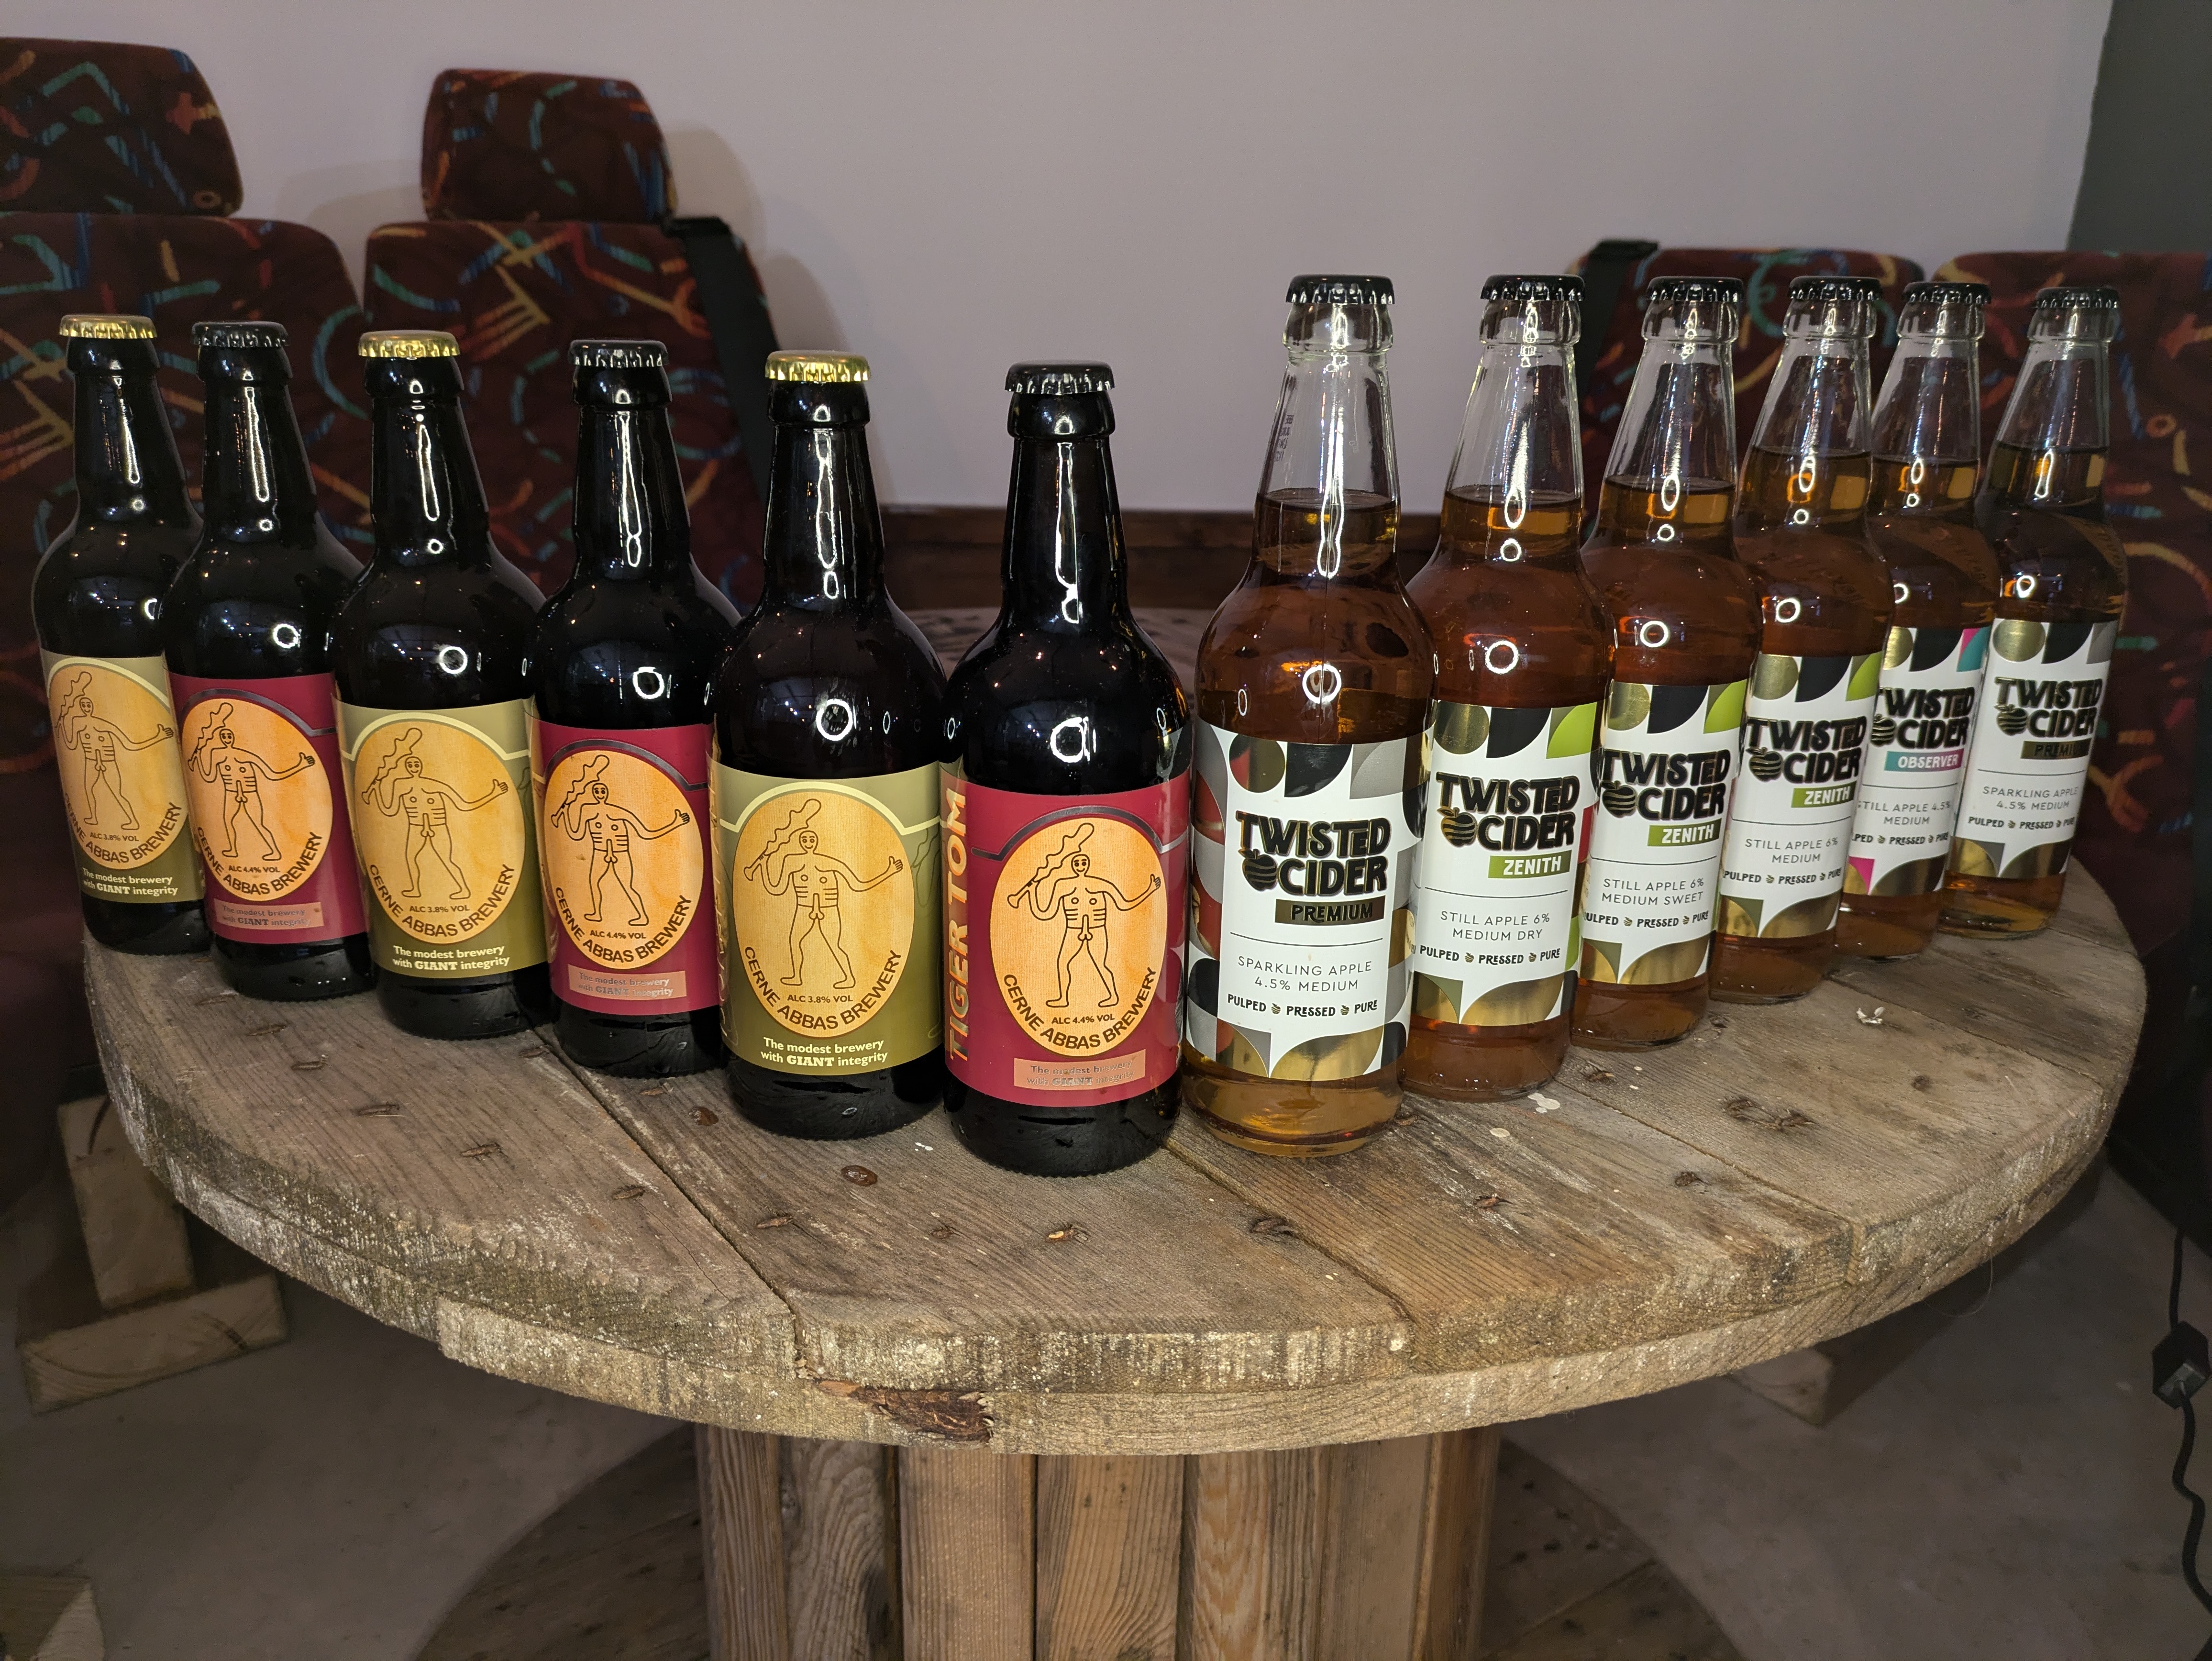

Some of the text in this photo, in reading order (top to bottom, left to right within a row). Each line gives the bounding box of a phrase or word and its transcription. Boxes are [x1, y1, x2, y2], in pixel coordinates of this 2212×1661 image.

[1994, 676, 2102, 709] TWISTED
[2027, 706, 2098, 738] CIDER
[1747, 716, 1867, 751] TWISTED
[1897, 717, 1969, 749] CIDER
[1603, 748, 1731, 787] TWISTED
[1783, 747, 1862, 784] CIDER
[1898, 754, 1958, 768] OBSERVER
[1436, 771, 1580, 814] TWISTED
[1803, 786, 1850, 805] ZENITH
[1982, 786, 2050, 798] SPARKLING
[1637, 783, 1726, 820] CIDER
[1892, 804, 1928, 812] APPLE
[1996, 800, 2069, 810] 4.5% MEDIUM
[1883, 817, 1930, 825] MEDIUM
[1968, 816, 2005, 828] PULPED
[2019, 821, 2054, 830] PRESSED
[86, 841, 129, 863] ABBAS
[130, 802, 182, 860] BREWERY
[90, 832, 102, 840] ALC
[1236, 810, 1391, 858] TWISTED
[1478, 812, 1576, 851] CIDER
[1661, 824, 1714, 844] ZENITH
[1745, 837, 1838, 850] STILL APPLE 6%
[1889, 836, 1925, 846] PRESSED
[198, 827, 323, 896] CERNE ABBAS BREWERY
[1503, 856, 1562, 875] ZENITH
[1771, 853, 1821, 864] MEDIUM
[82, 867, 172, 885] The modest brewery
[1278, 856, 1388, 896] CIDER
[1603, 877, 1704, 891] STILL APPLE 6%
[1723, 871, 1761, 883] PULPED
[1778, 874, 1816, 885] PRESSED
[97, 883, 130, 894] GIANT
[133, 886, 178, 897] integrity
[1602, 891, 1703, 905] MEDIUM SWEET
[370, 864, 515, 937] CERNE ABBAS BREWERY
[222, 905, 235, 913] The
[236, 908, 265, 916] modest
[1291, 902, 1373, 923] PREMIUM
[1440, 911, 1550, 926] STILL APPLE 6%
[238, 918, 269, 926] GIANT
[271, 918, 310, 927] integrity
[556, 887, 692, 963] CERNE ABBAS BREWERY
[946, 787, 969, 1061] TIGER TOM
[1584, 910, 1709, 929] ULPED PRESSED PURE
[590, 930, 605, 938] ALC
[1453, 928, 1543, 941] MEDIUM DRY
[393, 945, 505, 959] The modest brewery
[1420, 945, 1560, 965] PULPED PRESSED PURE
[392, 956, 510, 970] with GIANT integrity
[1238, 956, 1372, 976] SPARKLING APPLE
[578, 972, 670, 987] The modest brewery
[1255, 976, 1358, 992] 4.5% MEDIUM
[577, 983, 674, 998] with GIANT integrity
[745, 946, 901, 1030] CERNE ABBAS BREWERY
[1004, 967, 1156, 1050] CERNE ABBAS BREWERY
[1228, 994, 1378, 1017] PULPED PRESSED PURE
[1096, 1014, 1115, 1022] VOL
[763, 1037, 884, 1053] The modest brewery
[761, 1051, 888, 1067] with GIANT integrity
[1030, 1065, 1050, 1074] The
[1094, 1060, 1133, 1074] brewery
[1027, 1071, 1135, 1086] with GIANT integrity
